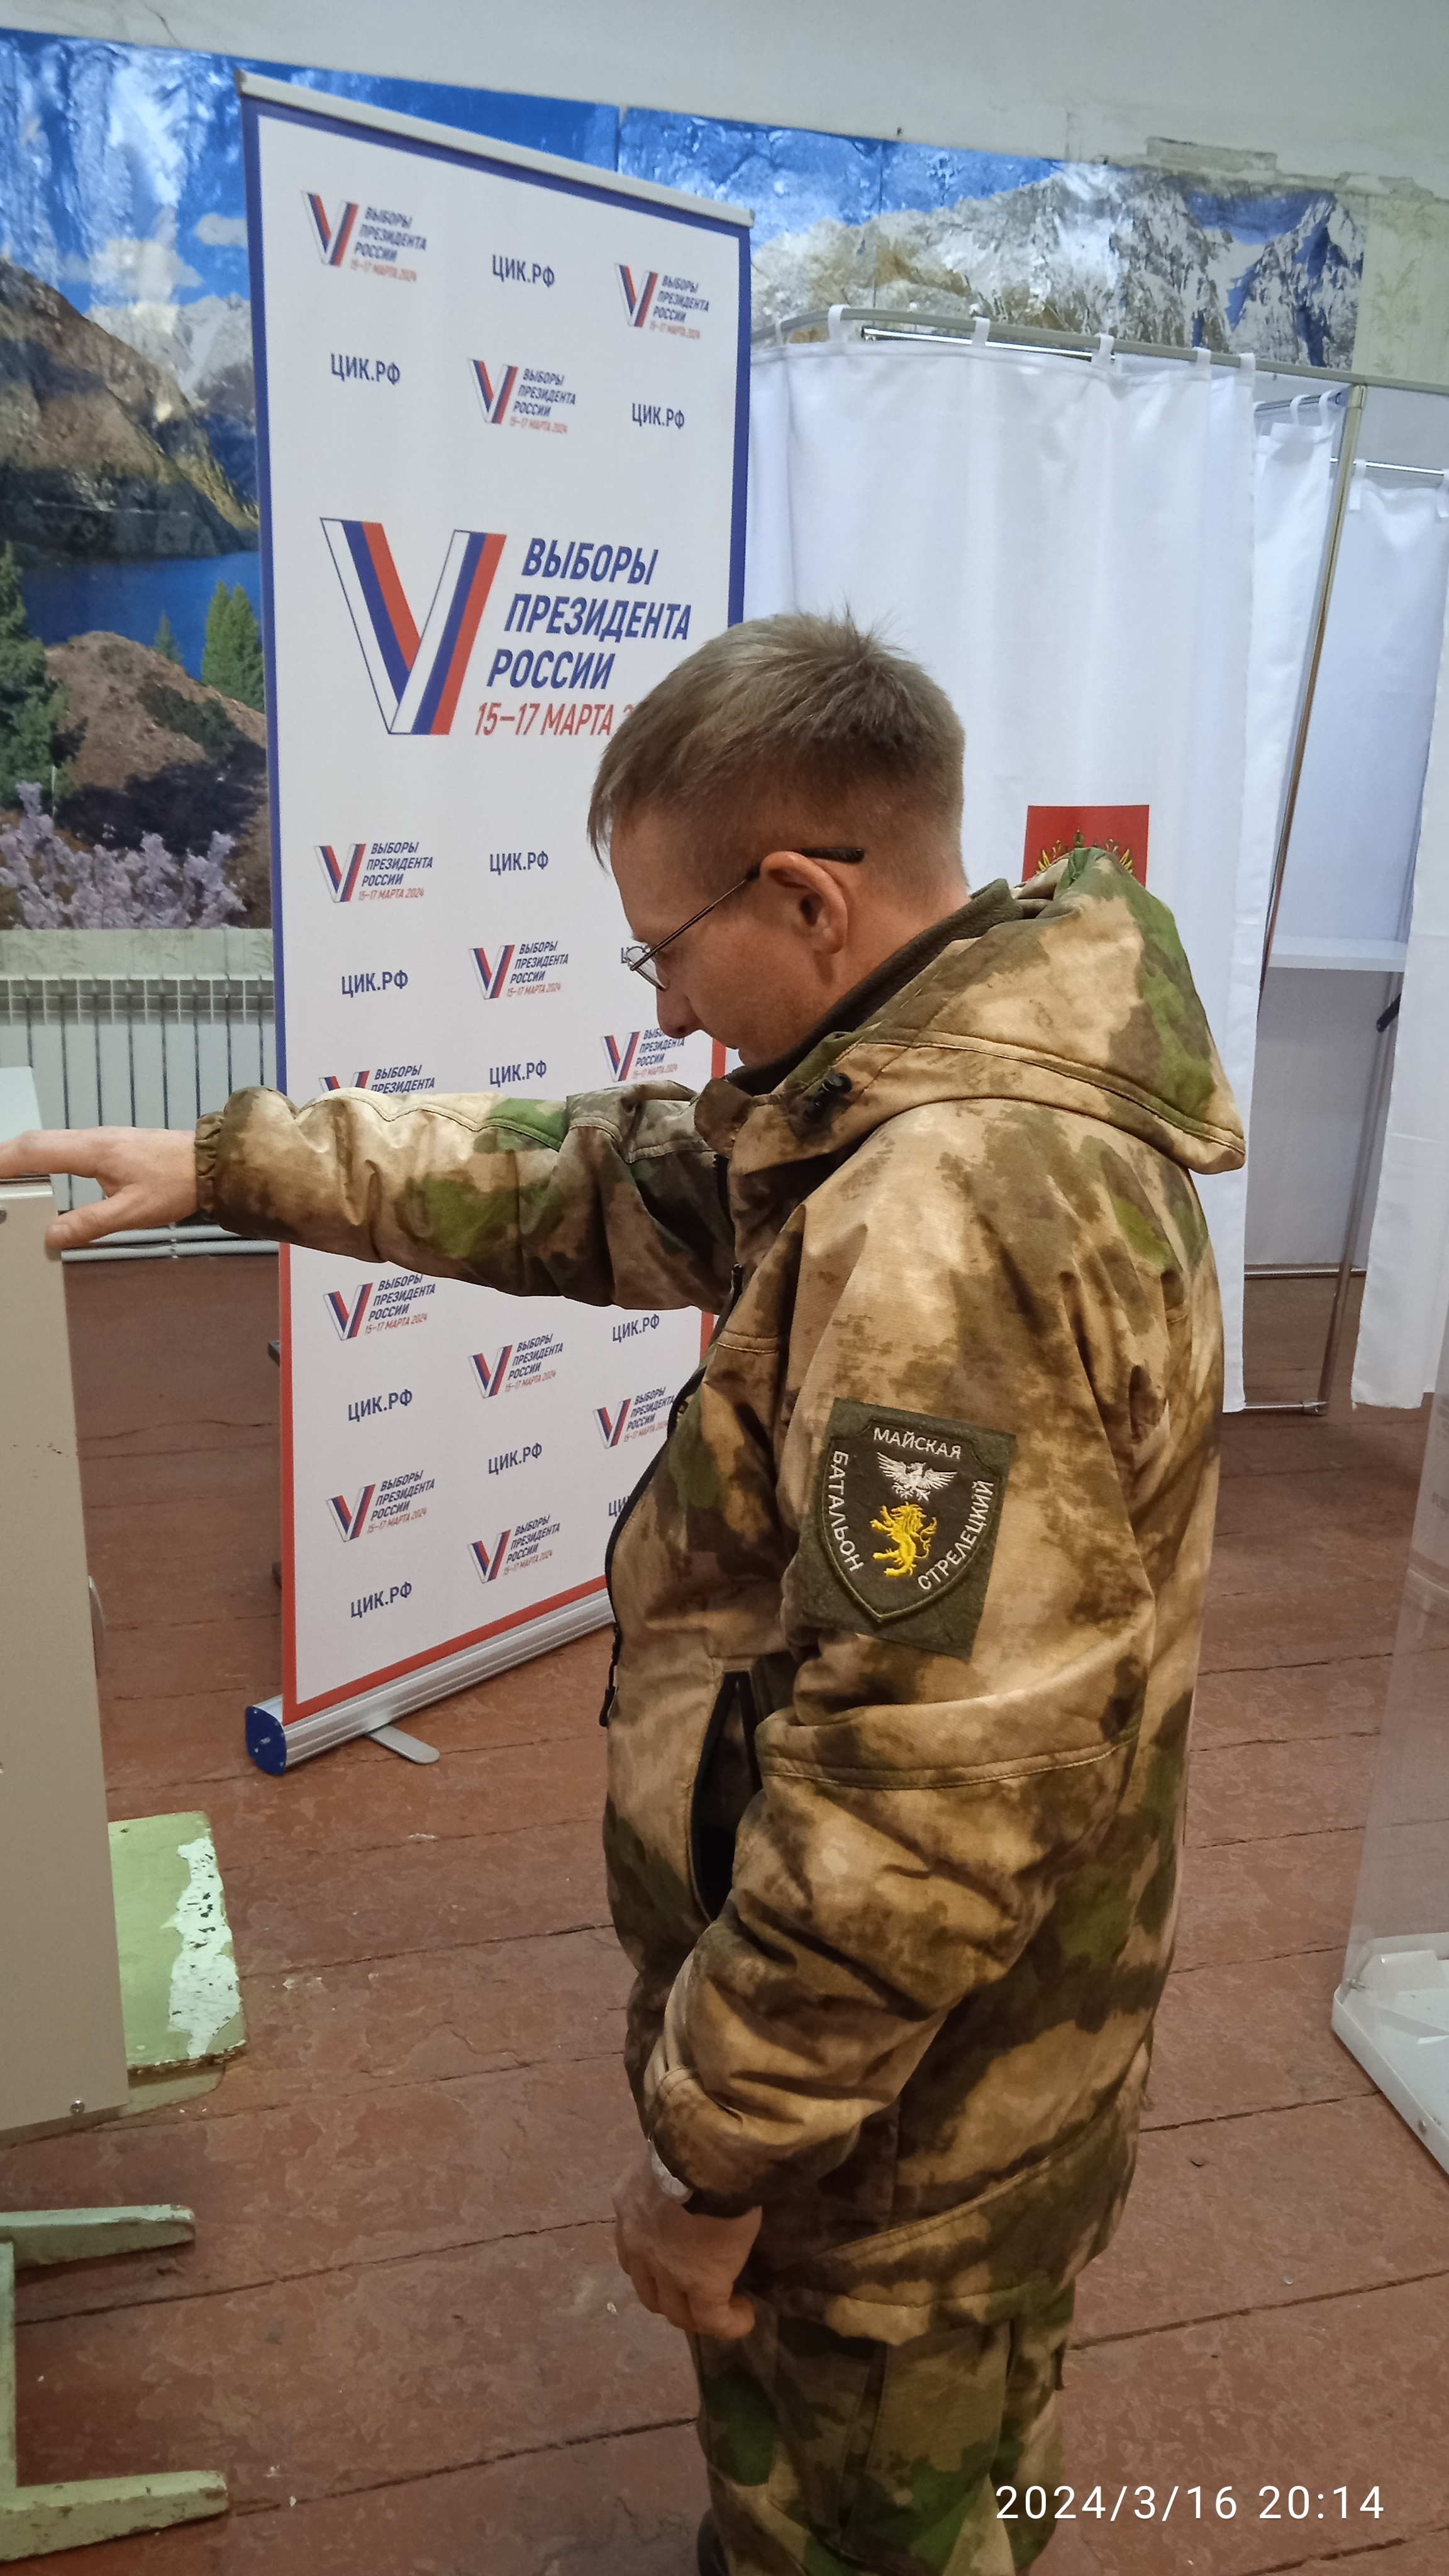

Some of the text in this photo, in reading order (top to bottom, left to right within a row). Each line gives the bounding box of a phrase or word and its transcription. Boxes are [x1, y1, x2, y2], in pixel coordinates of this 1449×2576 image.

[492, 254, 555, 288] ЦИК.РФ
[331, 353, 401, 386] ЦИК.РФ
[523, 368, 565, 386] ВЫБОРЫ
[518, 384, 576, 405] ПРЕЗИДЕНТА
[513, 400, 552, 417] РОССИИ
[632, 402, 686, 430] ЦИК.РФ
[521, 538, 659, 585] ВЫБОРЫ
[503, 594, 692, 643] ПРЕЗИДЕНТА
[486, 648, 616, 690] РОССИИ
[540, 703, 614, 736] МАРТА
[370, 841, 419, 854] ВЫБОРЫ
[367, 857, 433, 871] ПРЕЗИДЕНТА
[490, 852, 549, 876] ЦИК.РФ
[362, 874, 404, 887] РОССИИ
[519, 941, 558, 954] ВЫБОРЫ
[514, 954, 569, 969] ПРЕЗИДЕНТА
[341, 970, 408, 997] ЦИК.РФ
[510, 970, 546, 984] РОССИИ
[643, 1028, 665, 1040] ВЫБО
[374, 1065, 423, 1080] ВЫБОРЫ
[489, 1060, 547, 1087] ЦИК.РФ
[377, 1274, 423, 1291] ВЫБОРЫ
[373, 1284, 435, 1306] ПРЕЗИДЕНТА
[368, 1304, 410, 1321] РОССИИ
[613, 1314, 660, 1343] ЦИК.РФ
[516, 1333, 553, 1353] ВЫБОРЫ
[513, 1343, 564, 1366] ПРЕЗИДЕНТА
[508, 1362, 541, 1380] РОССИИ
[348, 1389, 413, 1422] ЦИК.РФ
[630, 1394, 675, 1418] ПРЕЗИДЕНТА
[634, 1386, 666, 1406] ВЫБОРЫ
[626, 1413, 655, 1431] РОССИИ
[873, 1427, 962, 1460] МАЙСКАЯ
[488, 1443, 542, 1475] ЦИК.РФ
[380, 1470, 424, 1492] ВЫБОРЫ
[375, 1479, 435, 1506] ПРЕЗИДЕНТА
[370, 1501, 411, 1521] РОССИИ
[826, 1450, 864, 1572] БАТАЛЬОН
[514, 1514, 550, 1536] ВЫБОРЫ
[917, 1480, 995, 1591] СТРЕЛЕЦКИЙ
[511, 1523, 560, 1550] ПРЕЗИДЕНТА
[506, 1543, 539, 1563] РОССИИ
[350, 1581, 413, 1618] ЦИК.РФ
